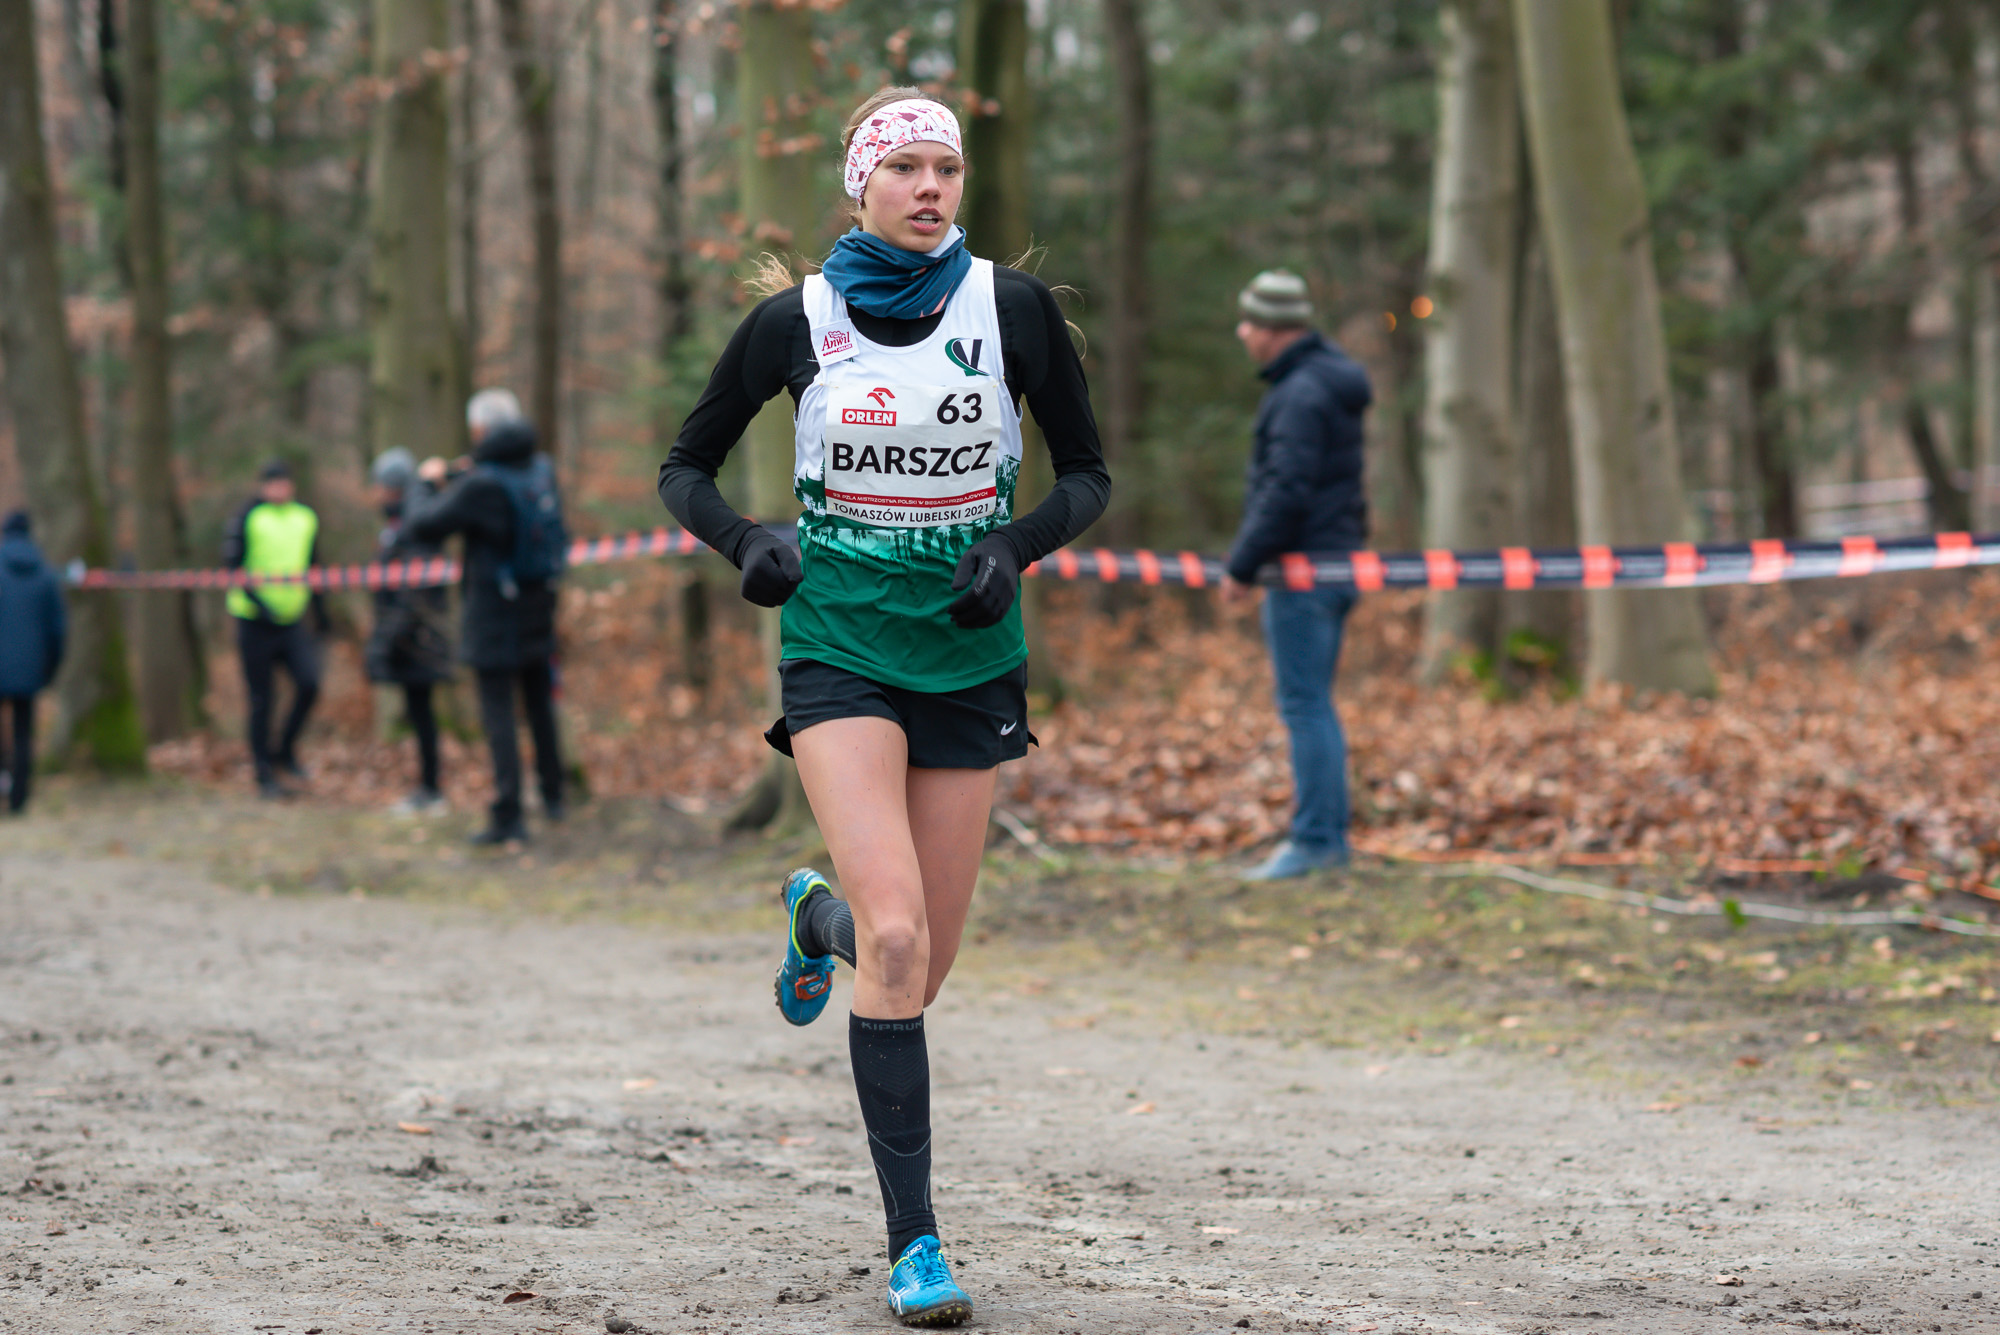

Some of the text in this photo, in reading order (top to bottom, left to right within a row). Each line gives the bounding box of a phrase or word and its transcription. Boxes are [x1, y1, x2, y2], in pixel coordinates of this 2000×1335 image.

[821, 331, 851, 351] Anwil
[844, 410, 895, 425] ORLEN
[936, 392, 982, 425] 63
[832, 440, 993, 477] BARSZCZ
[857, 496, 897, 504] MISTRZOSTWA
[833, 502, 989, 523] TOMASZÓW LUBELSKI 2021
[861, 1020, 922, 1031] KIPRUN
